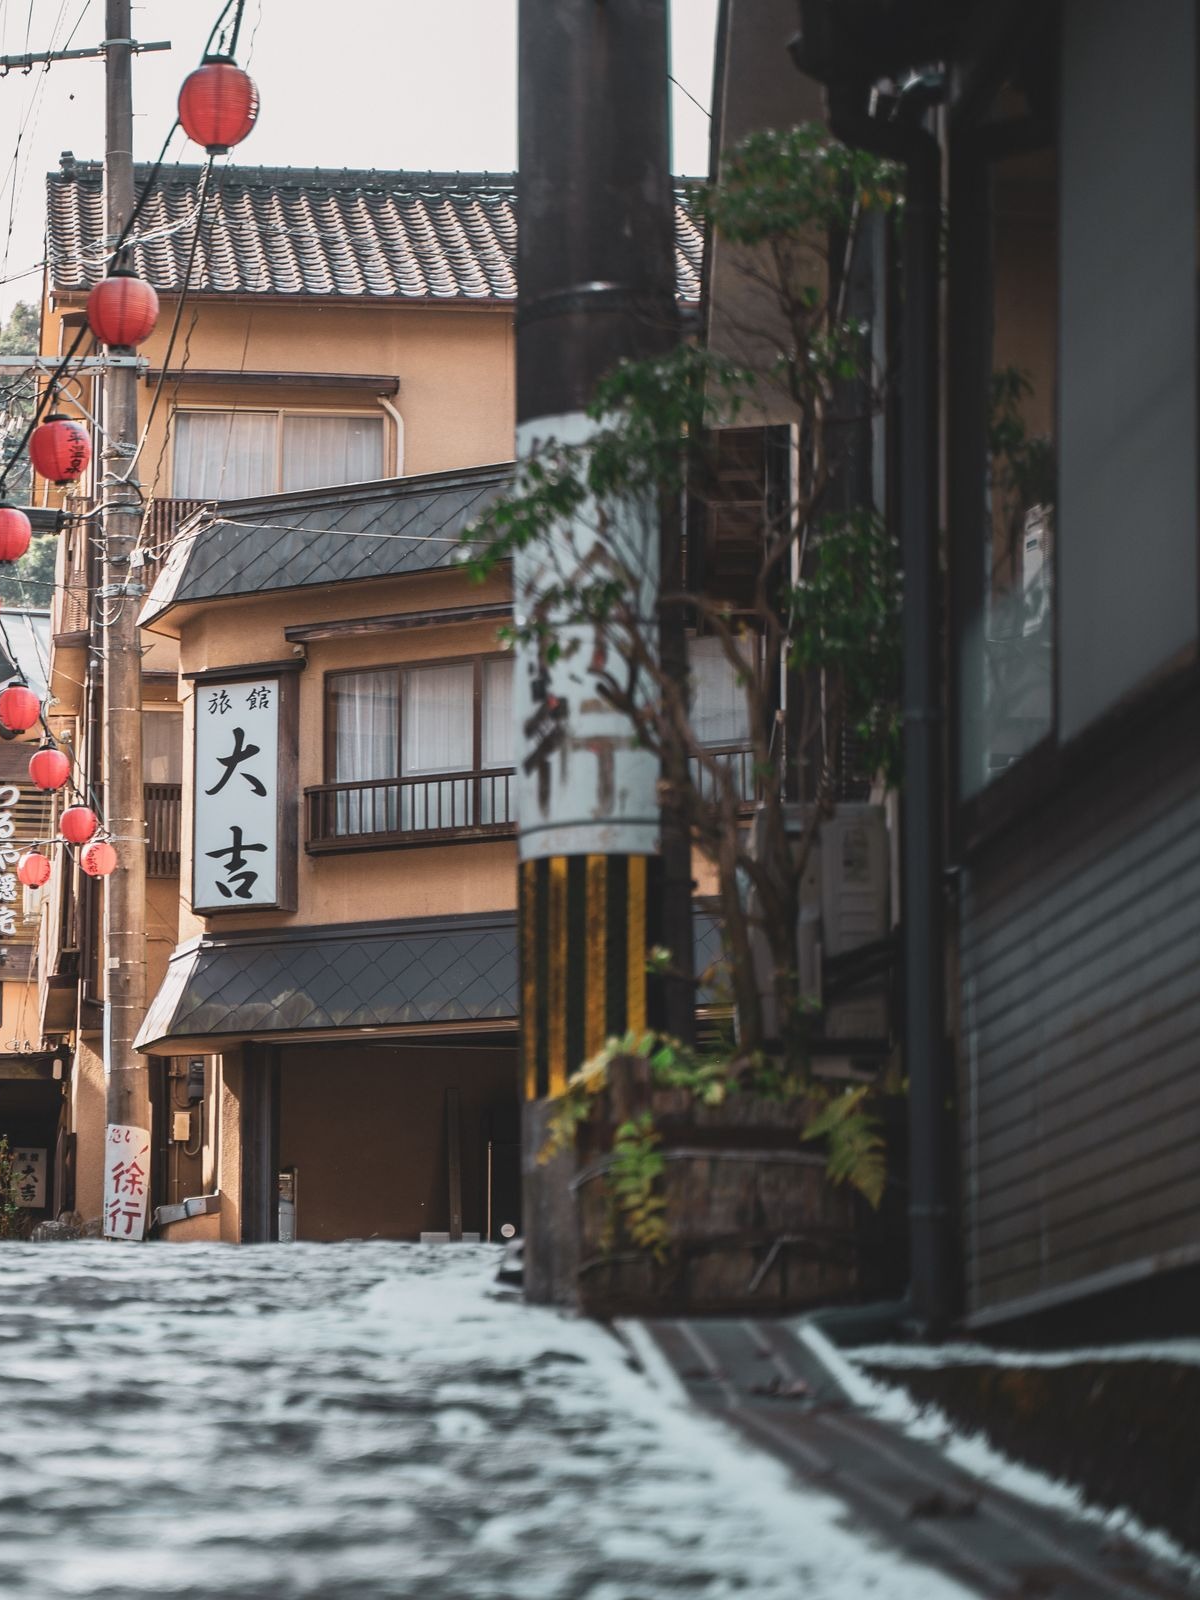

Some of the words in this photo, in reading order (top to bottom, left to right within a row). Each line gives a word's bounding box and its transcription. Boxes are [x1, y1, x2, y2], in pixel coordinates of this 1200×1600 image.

[208, 686, 272, 715] 旅館
[204, 727, 268, 899] 大吉
[109, 1161, 145, 1235] 徐行
